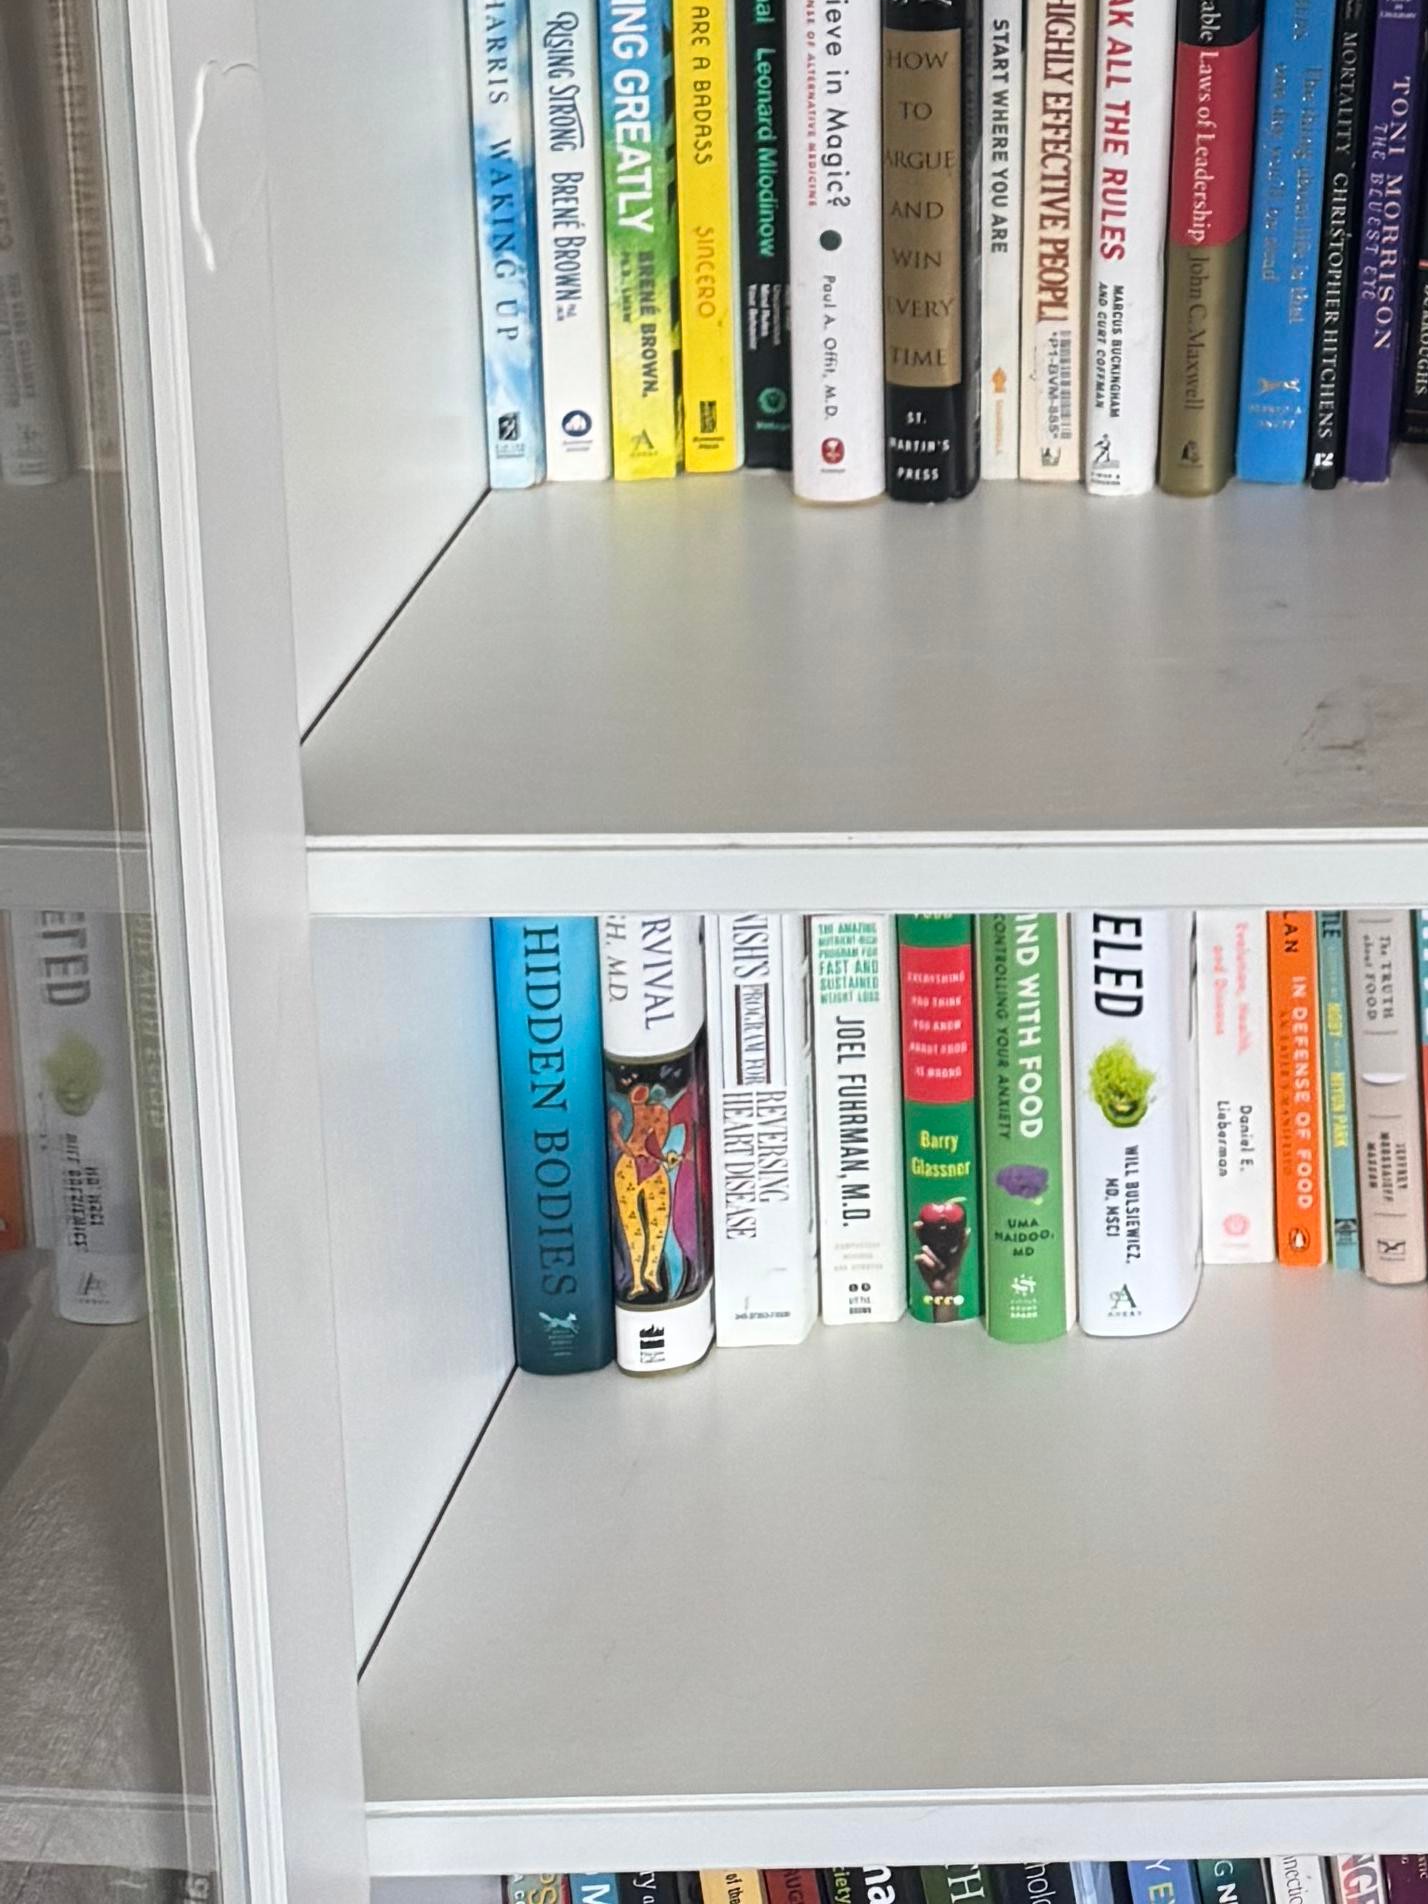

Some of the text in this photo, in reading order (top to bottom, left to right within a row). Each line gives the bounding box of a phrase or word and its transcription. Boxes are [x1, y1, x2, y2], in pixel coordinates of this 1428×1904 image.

[885, 50, 948, 69] HOW
[899, 101, 932, 120] TO
[891, 201, 943, 221] AND
[891, 250, 942, 270] WIN
[889, 346, 947, 367] TIME
[836, 1014, 867, 1066] JOEL
[837, 1075, 872, 1181] FUHRMAN,
[920, 1130, 959, 1154] Barry
[911, 1154, 970, 1178] Glassner
[841, 1185, 871, 1230] M.D.
[1012, 1244, 1034, 1256] MD
